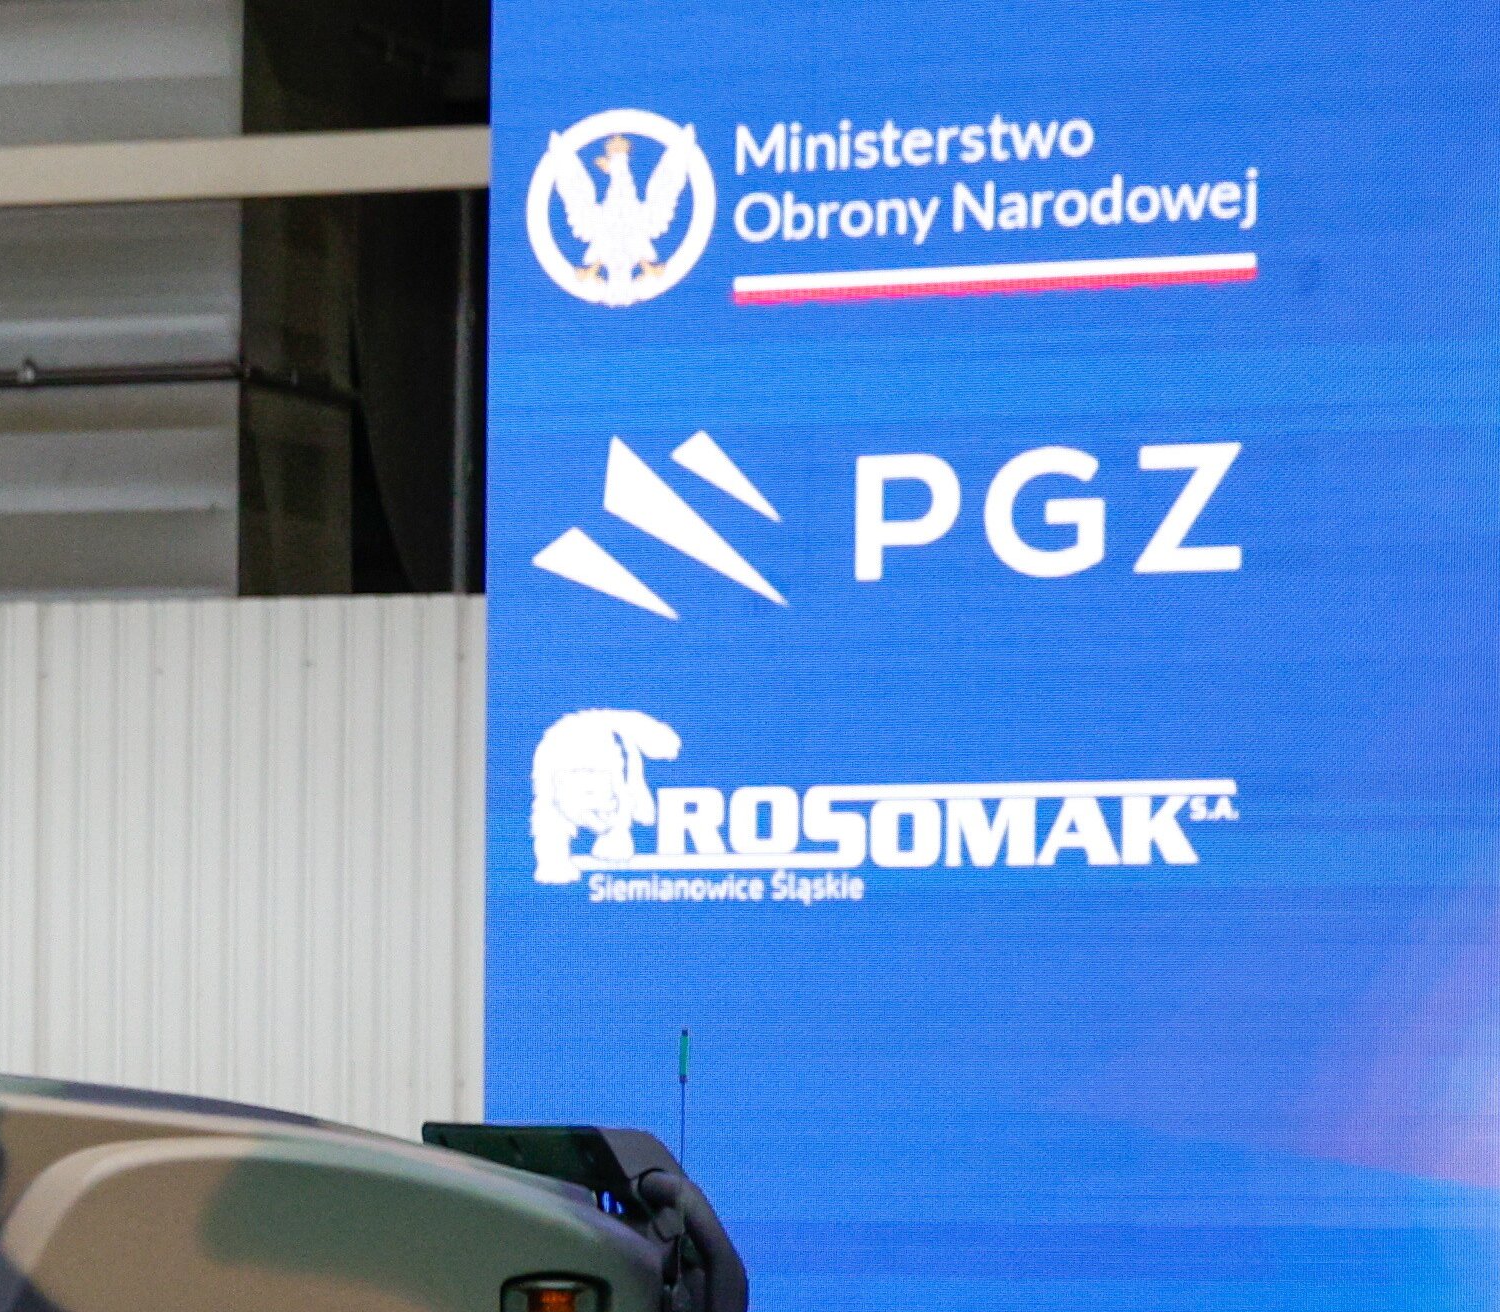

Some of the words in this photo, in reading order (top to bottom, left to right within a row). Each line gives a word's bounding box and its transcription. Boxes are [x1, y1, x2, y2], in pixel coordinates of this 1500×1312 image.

[734, 113, 1095, 176] Ministerstwo
[733, 190, 940, 245] Obrony
[951, 166, 1259, 232] Narodowej
[853, 441, 1243, 583] PGZ
[655, 779, 1202, 868] ROSOMAK
[588, 873, 765, 903] Siemianowice
[770, 868, 866, 907] Śląskie
